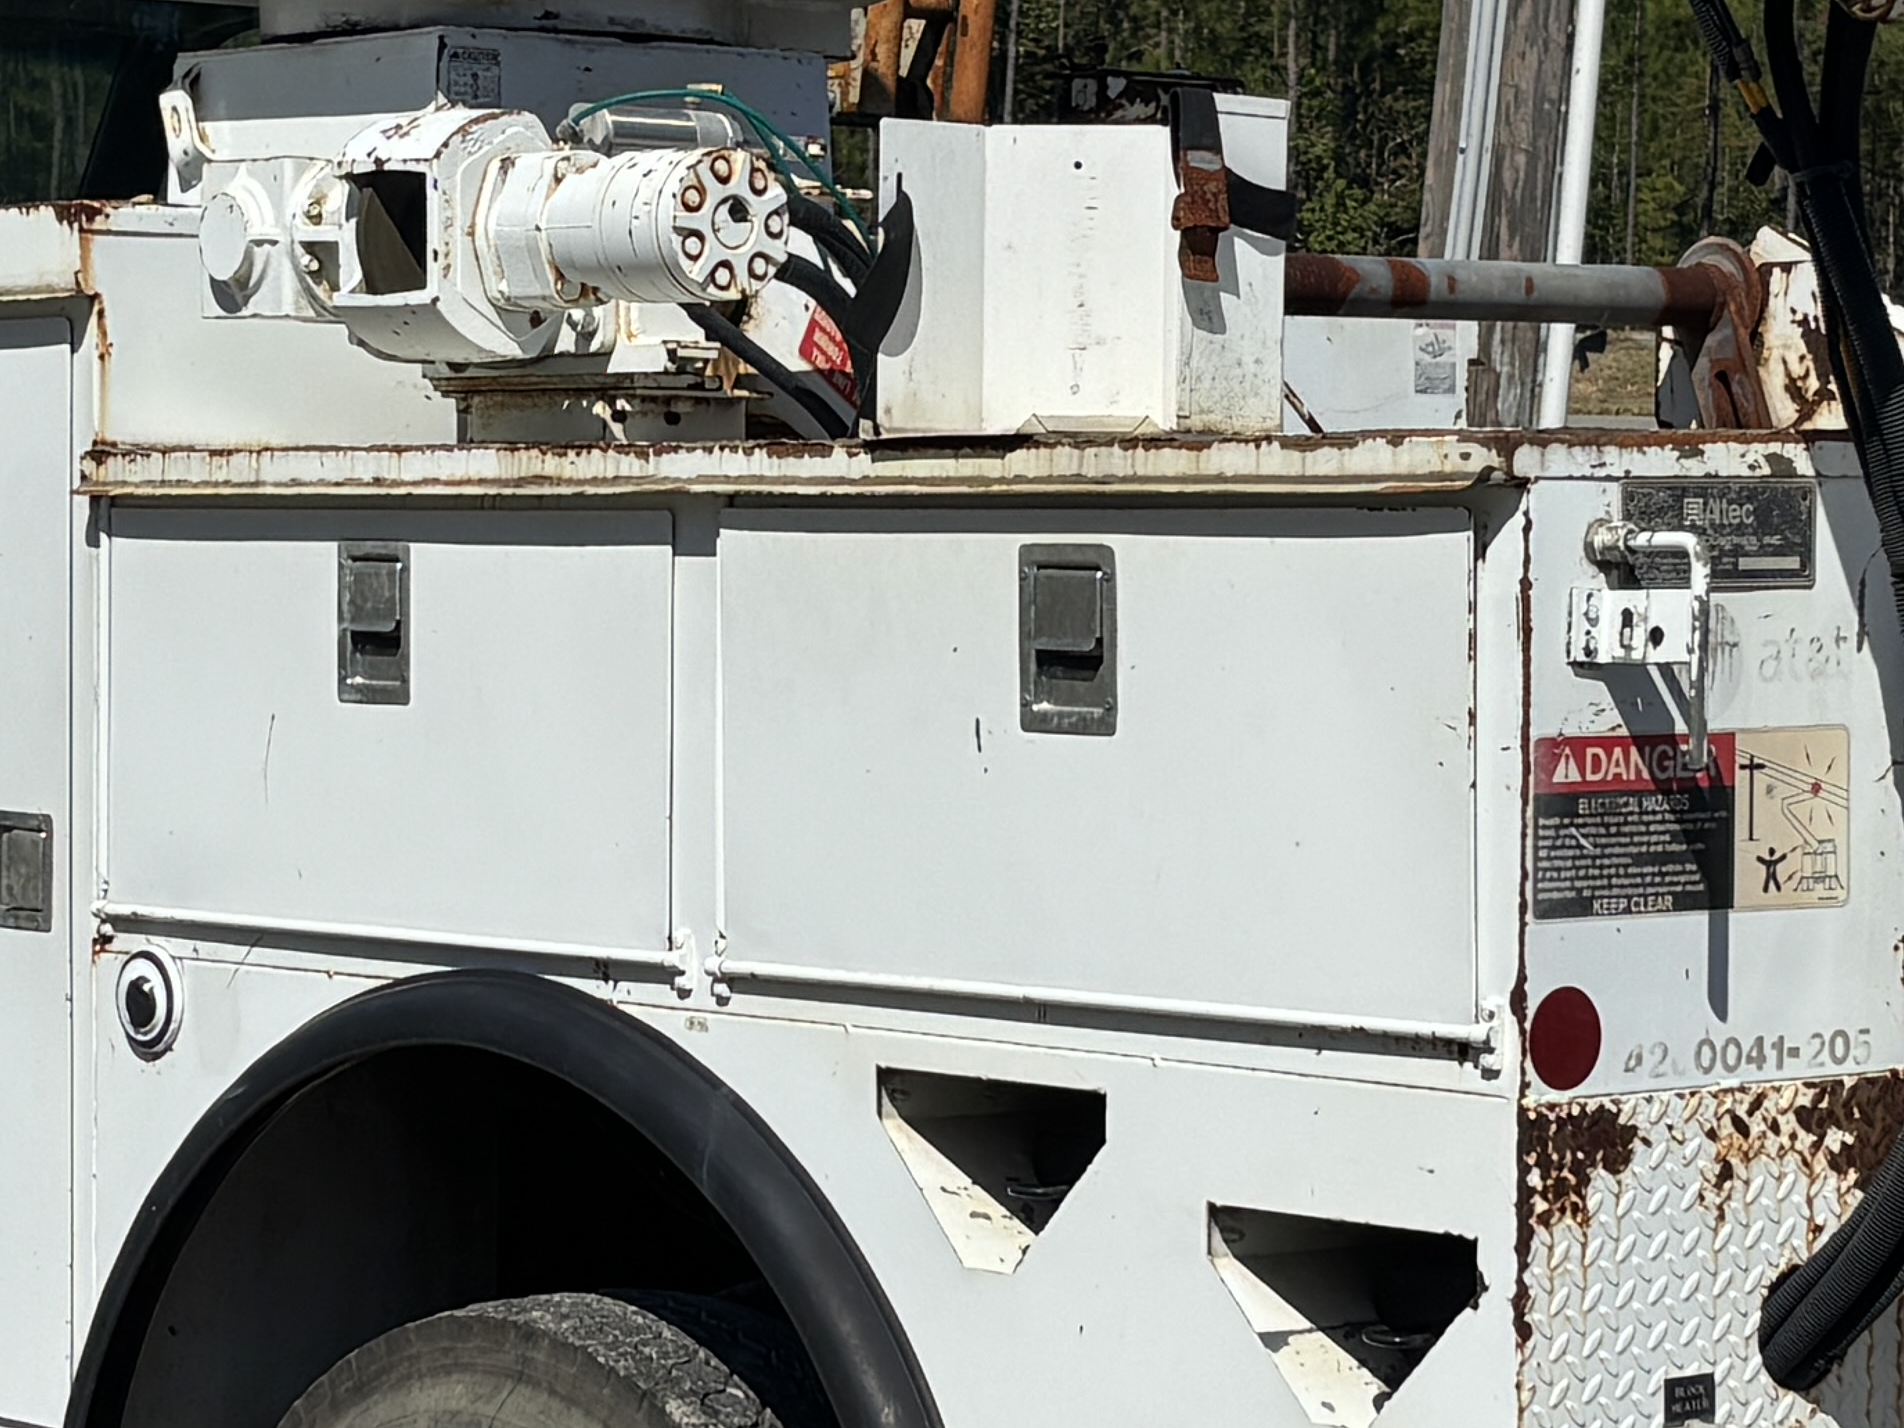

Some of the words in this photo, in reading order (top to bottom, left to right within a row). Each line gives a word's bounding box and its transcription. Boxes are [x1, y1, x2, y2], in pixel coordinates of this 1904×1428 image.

[1706, 498, 1755, 524] Altec
[1592, 898, 1627, 915] KEEP
[1630, 895, 1673, 912] CLEAR
